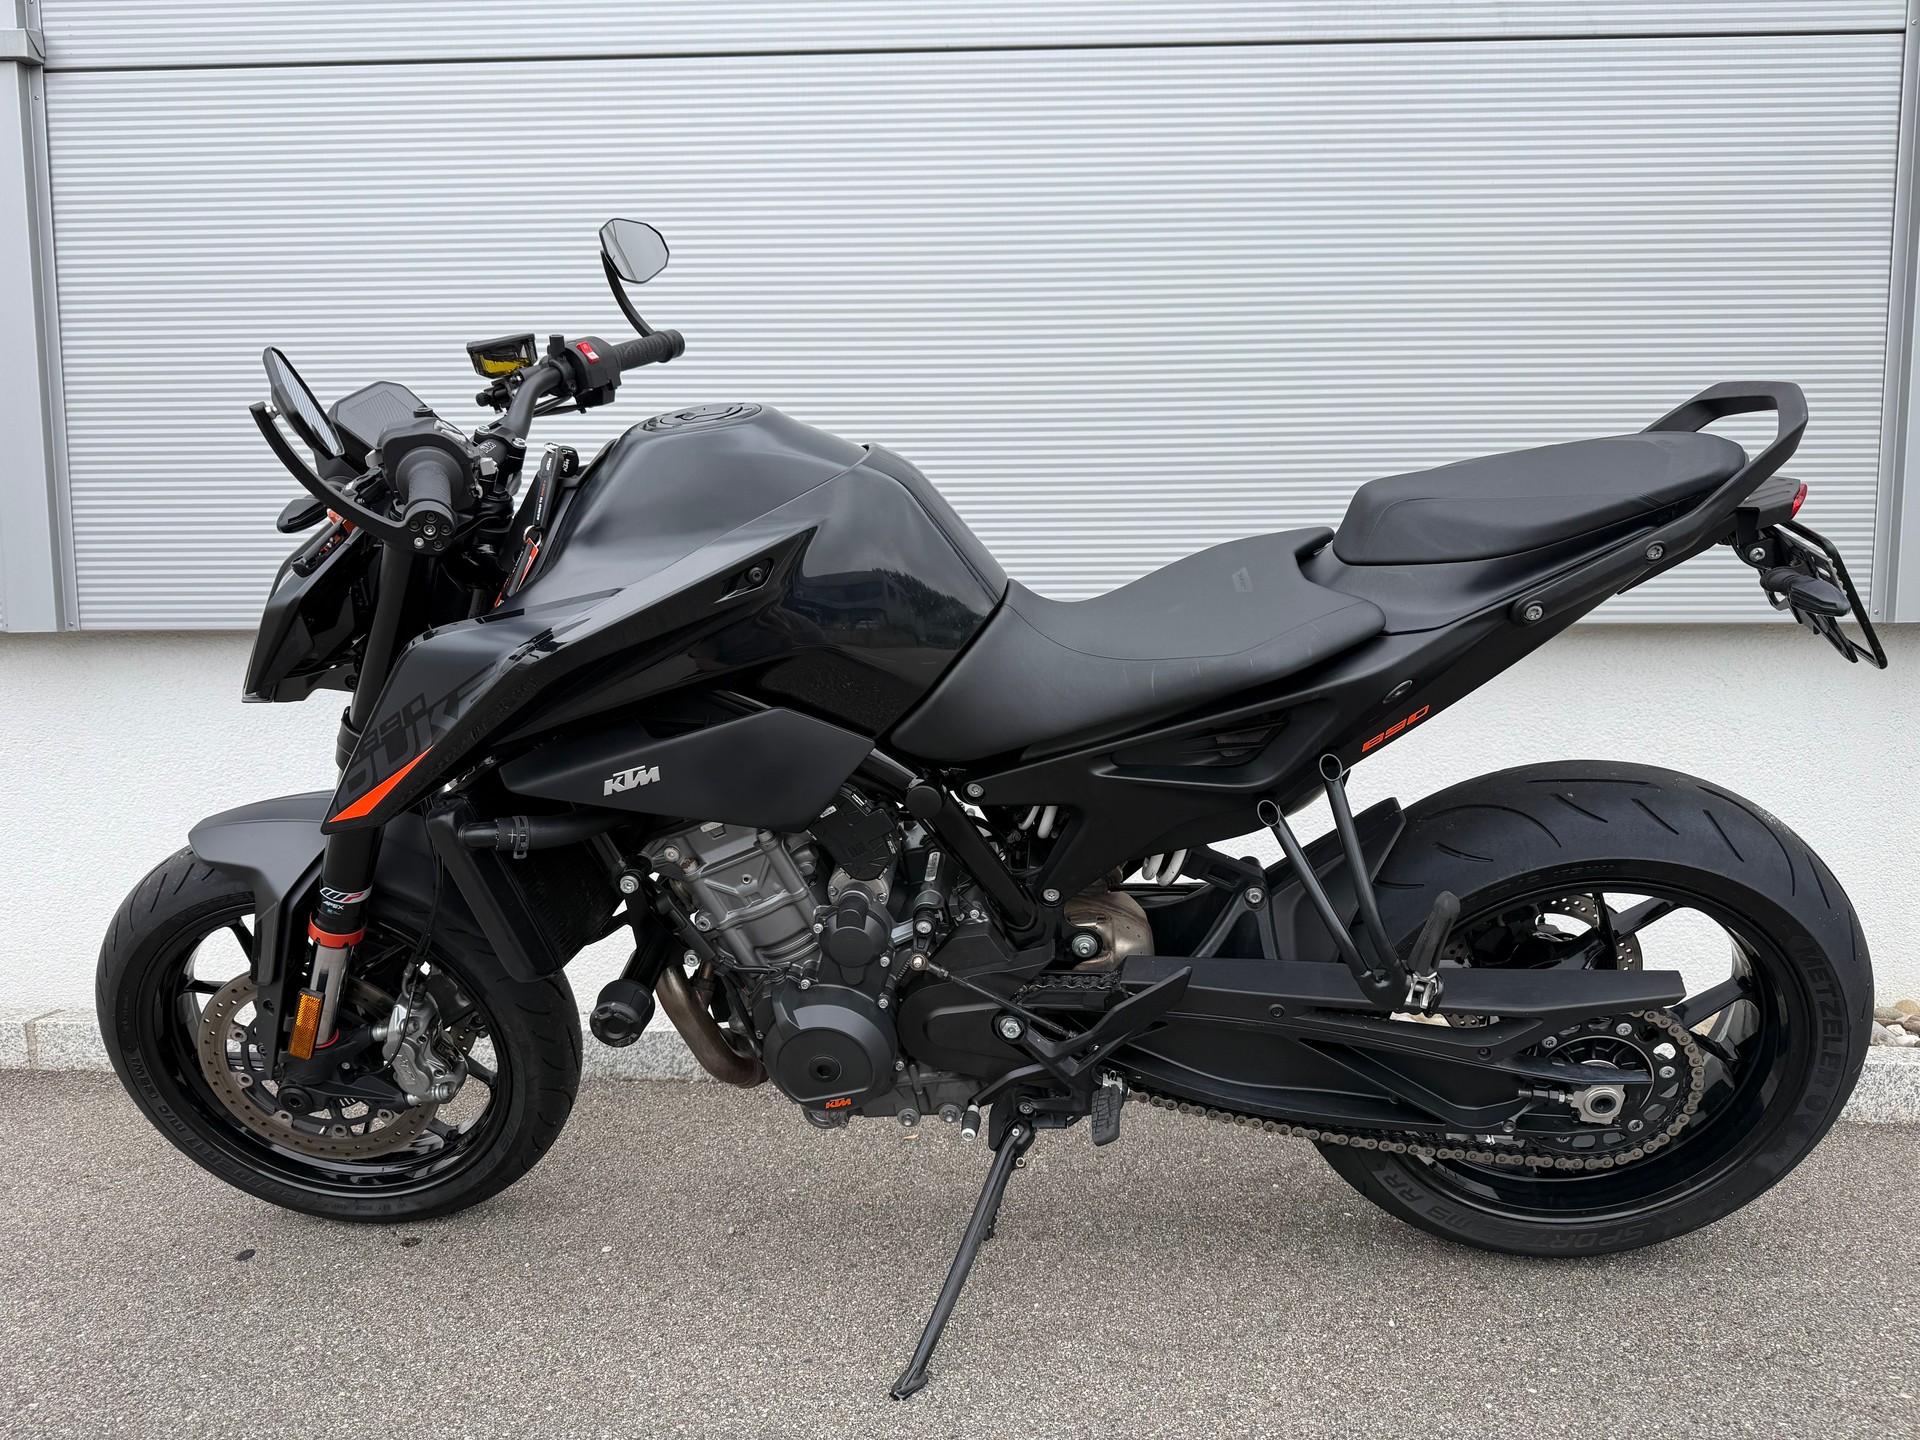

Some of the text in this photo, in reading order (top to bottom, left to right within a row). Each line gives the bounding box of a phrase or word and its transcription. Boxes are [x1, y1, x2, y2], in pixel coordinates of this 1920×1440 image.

[1361, 703, 1431, 754] 890
[603, 764, 661, 797] KTM
[323, 900, 345, 911] APEX
[1801, 942, 1845, 1089] METZELER
[825, 1097, 853, 1110] KTM
[1383, 1171, 1425, 1202] RR
